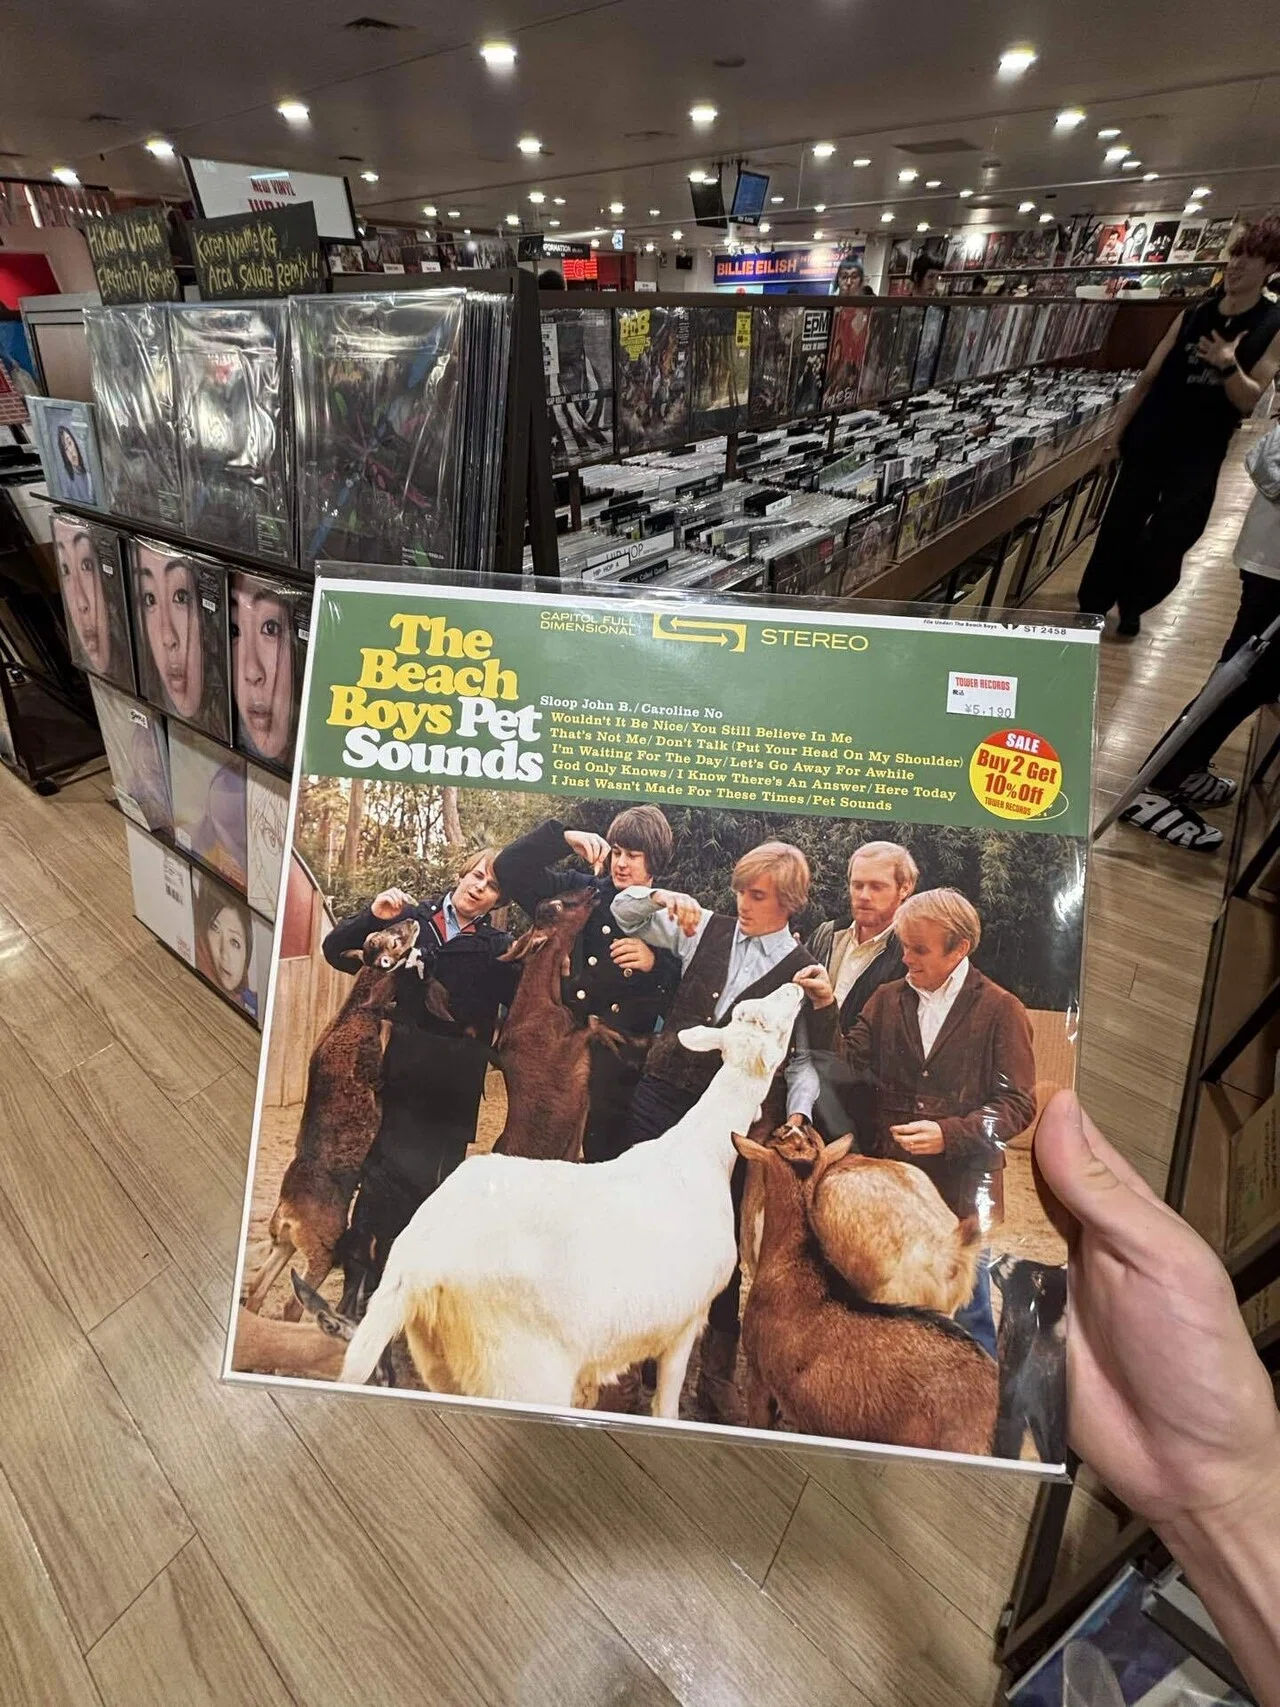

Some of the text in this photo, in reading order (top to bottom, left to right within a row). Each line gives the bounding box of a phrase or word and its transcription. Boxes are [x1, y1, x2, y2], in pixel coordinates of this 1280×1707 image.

[271, 180, 296, 196] VINYL
[124, 217, 162, 253] Utada
[192, 231, 225, 268] Karen
[717, 260, 754, 276] BILLIE
[756, 258, 797, 274] EILISH
[603, 563, 614, 573] HOP
[540, 611, 637, 627] CAPITOL FULL
[540, 620, 637, 636] DIMENSIONAL
[1023, 625, 1067, 636] ST 2458
[389, 613, 493, 660] The
[760, 628, 869, 651] STEREO
[356, 648, 519, 700] Beach
[955, 676, 1011, 692] TOWER RECORDS
[326, 685, 543, 742] Boys Pet
[540, 695, 578, 710] Sloop
[581, 698, 614, 711] John
[704, 708, 723, 719] No
[551, 712, 611, 726] Wouldn't
[615, 717, 626, 728] It
[631, 718, 648, 729] Be
[721, 725, 751, 737] Still
[755, 727, 806, 740] Believe
[811, 731, 826, 742] In
[831, 732, 853, 744] Me
[1006, 732, 1041, 753] SALE
[342, 727, 544, 782] Sounds
[550, 727, 592, 741] That's
[596, 731, 621, 743] Not
[697, 739, 728, 751] Talk
[732, 740, 760, 754] (Put
[764, 743, 798, 756] Your
[801, 746, 838, 759] Head
[843, 750, 864, 761] On
[868, 751, 891, 764] My
[895, 753, 964, 769] Shoulder)
[552, 743, 574, 755] I'm
[579, 745, 633, 761] Waiting
[637, 750, 661, 762] For
[665, 752, 691, 764] The
[769, 760, 788, 772] Go
[793, 761, 831, 776] Away
[836, 764, 861, 776] For
[865, 767, 915, 781] Awhile
[553, 760, 580, 772] God
[585, 762, 617, 776] Only
[688, 770, 727, 783] Know
[731, 773, 783, 787] There's
[787, 777, 807, 789] An
[913, 786, 957, 801] Today
[977, 748, 1057, 784] Buy 2 Get
[551, 775, 558, 785] I
[561, 775, 590, 788] Just
[595, 778, 641, 792] Wasn't
[644, 782, 683, 795] Made
[687, 785, 712, 797] For
[716, 787, 757, 801] These
[840, 797, 892, 811] Sounds
[985, 796, 1031, 816] TOWER RECORDS
[1127, 792, 1202, 849] AIR
